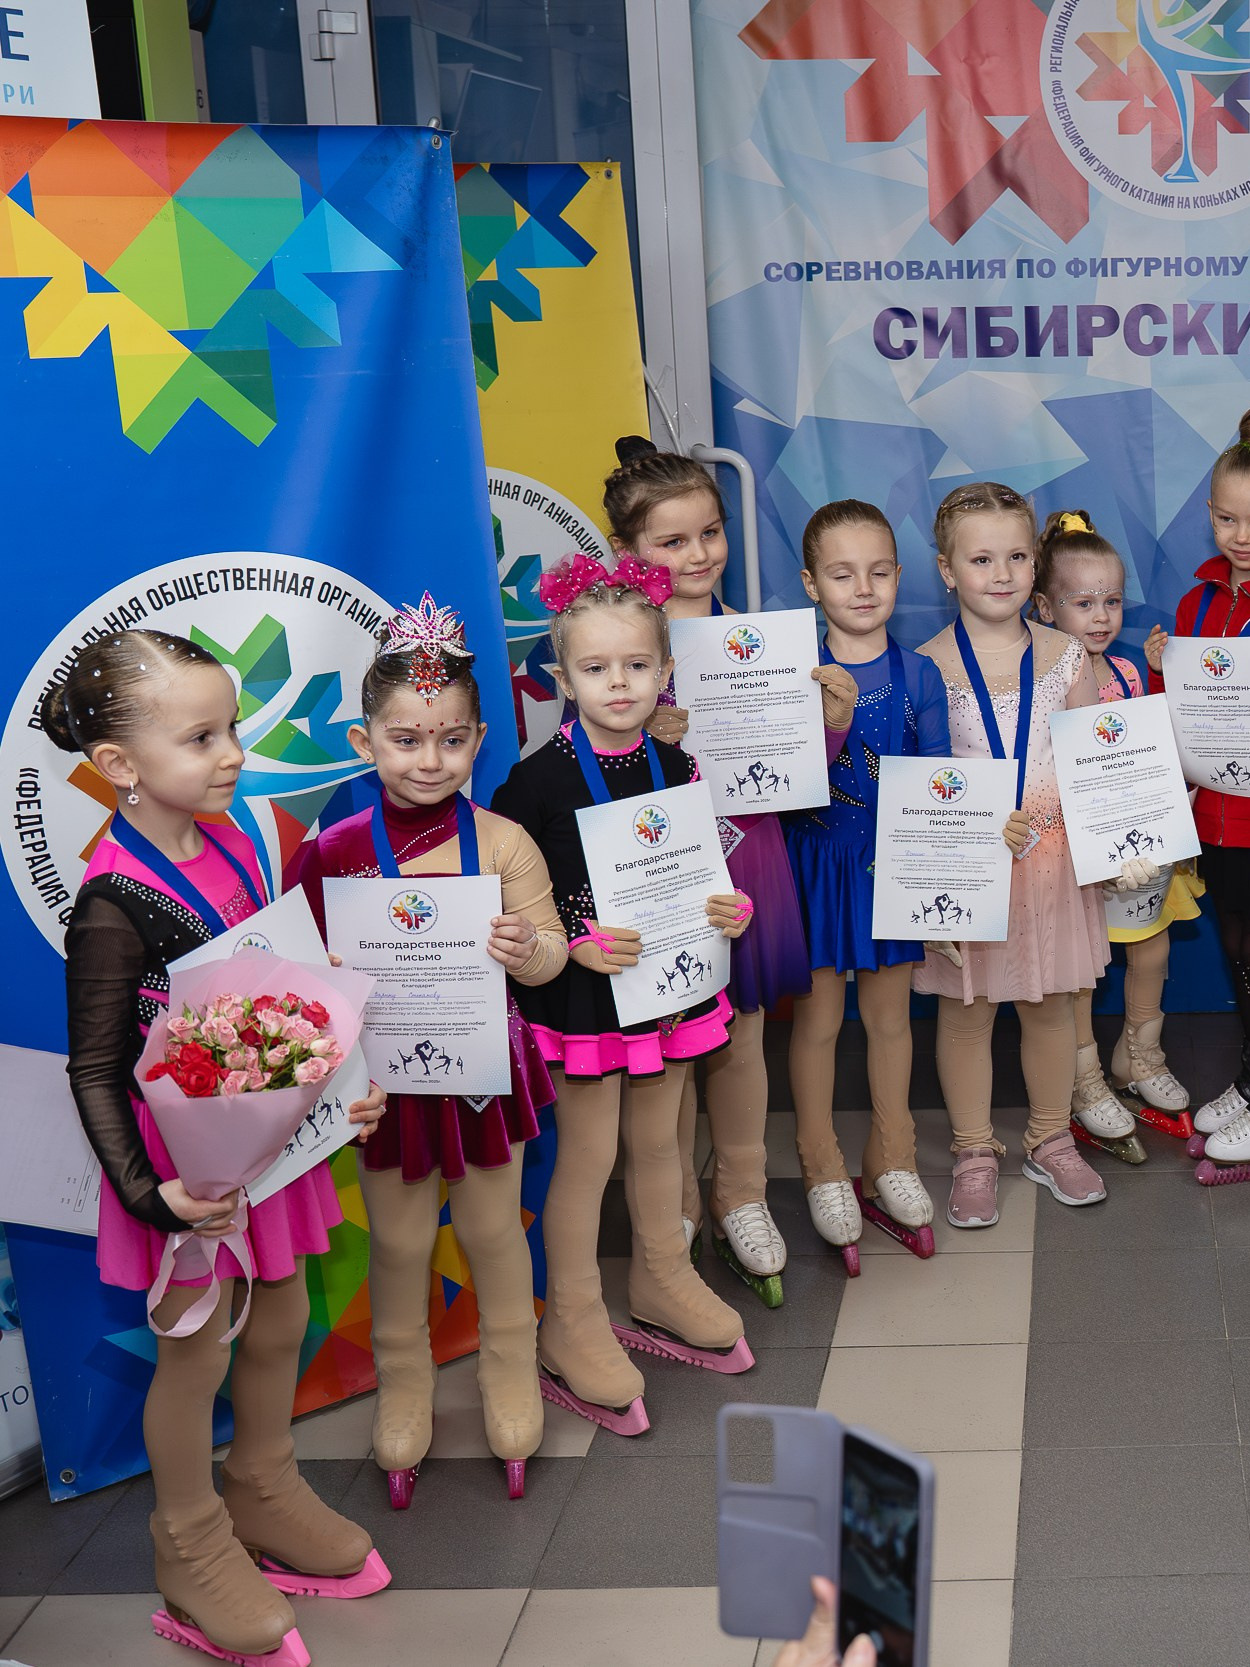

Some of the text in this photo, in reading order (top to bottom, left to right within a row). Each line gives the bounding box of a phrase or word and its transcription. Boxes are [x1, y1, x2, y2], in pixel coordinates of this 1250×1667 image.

[1052, 79, 1085, 150] «ФЕДЕРАЦИЯ
[1079, 146, 1129, 193] ФИГУРНОГО
[1129, 185, 1175, 209] КАТАНИЯ
[1177, 196, 1191, 210] НА
[1193, 186, 1241, 209] КОНЬКАХ
[763, 258, 1007, 283] СОРЕВНОВАНИЯ
[1016, 258, 1056, 279] ПО
[1065, 255, 1249, 278] ФИГУРНОМУ
[522, 488, 604, 561] ОРГАНИЗАЦИЯ
[146, 567, 315, 612] ОБЩЕСТВЕННАЯ
[317, 581, 389, 640] ОРГАНИЗ
[700, 666, 797, 682] Благодарственное
[730, 680, 769, 691] письмо
[1075, 744, 1157, 766] Благодарственное
[1102, 759, 1135, 772] письмо
[902, 807, 994, 818] Благодарственное
[929, 819, 966, 827] письмо
[14, 766, 71, 910] «ФЕДЕРАЦИЯ
[614, 842, 702, 874] Благодарственное
[645, 862, 680, 878] письмо
[358, 939, 476, 951] Благодарственное
[395, 953, 442, 962] письмо
